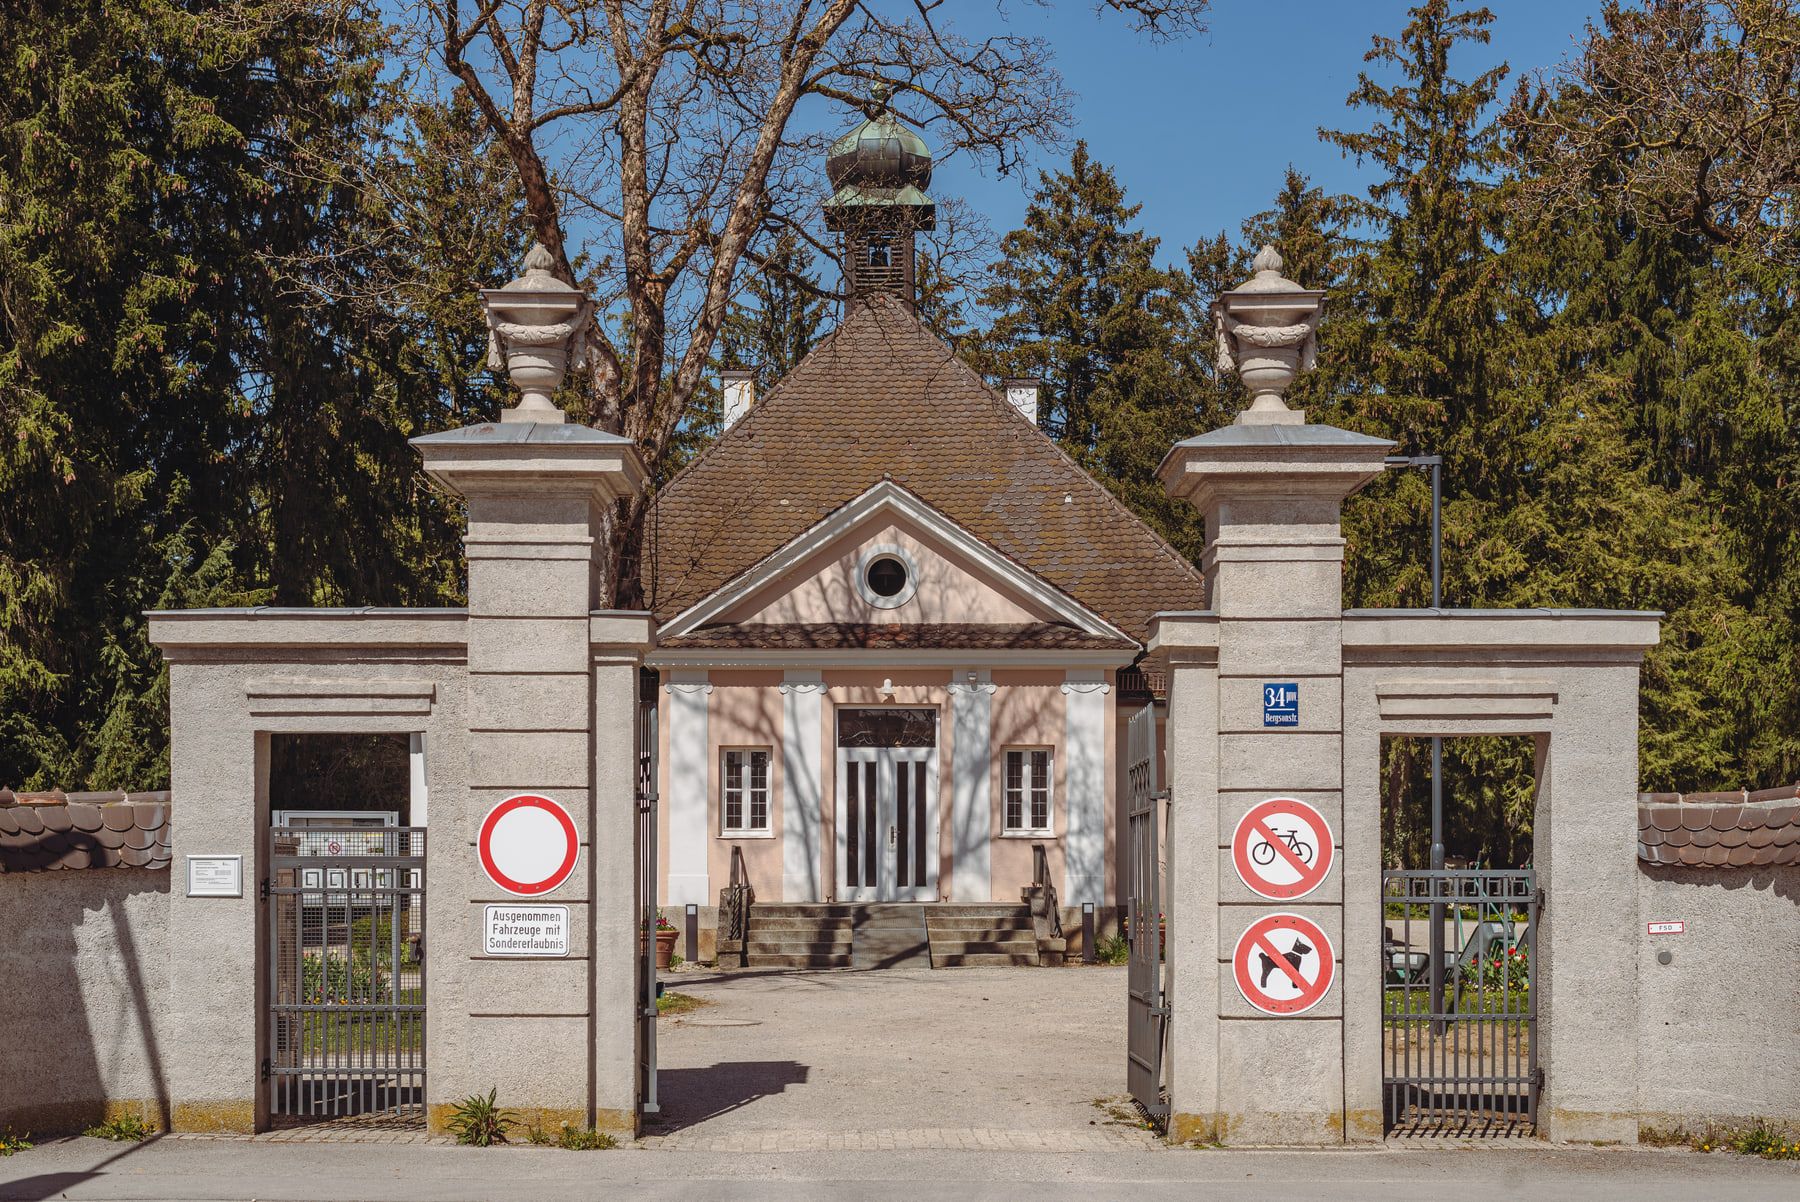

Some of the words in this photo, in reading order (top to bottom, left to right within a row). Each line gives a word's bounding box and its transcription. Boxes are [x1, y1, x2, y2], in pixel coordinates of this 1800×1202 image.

[1265, 687, 1285, 707] 34
[493, 910, 560, 923] Ausgenommen
[493, 924, 541, 936] Fahrzeuge
[545, 924, 560, 935] mit
[489, 938, 564, 949] Sondererlaubnis
